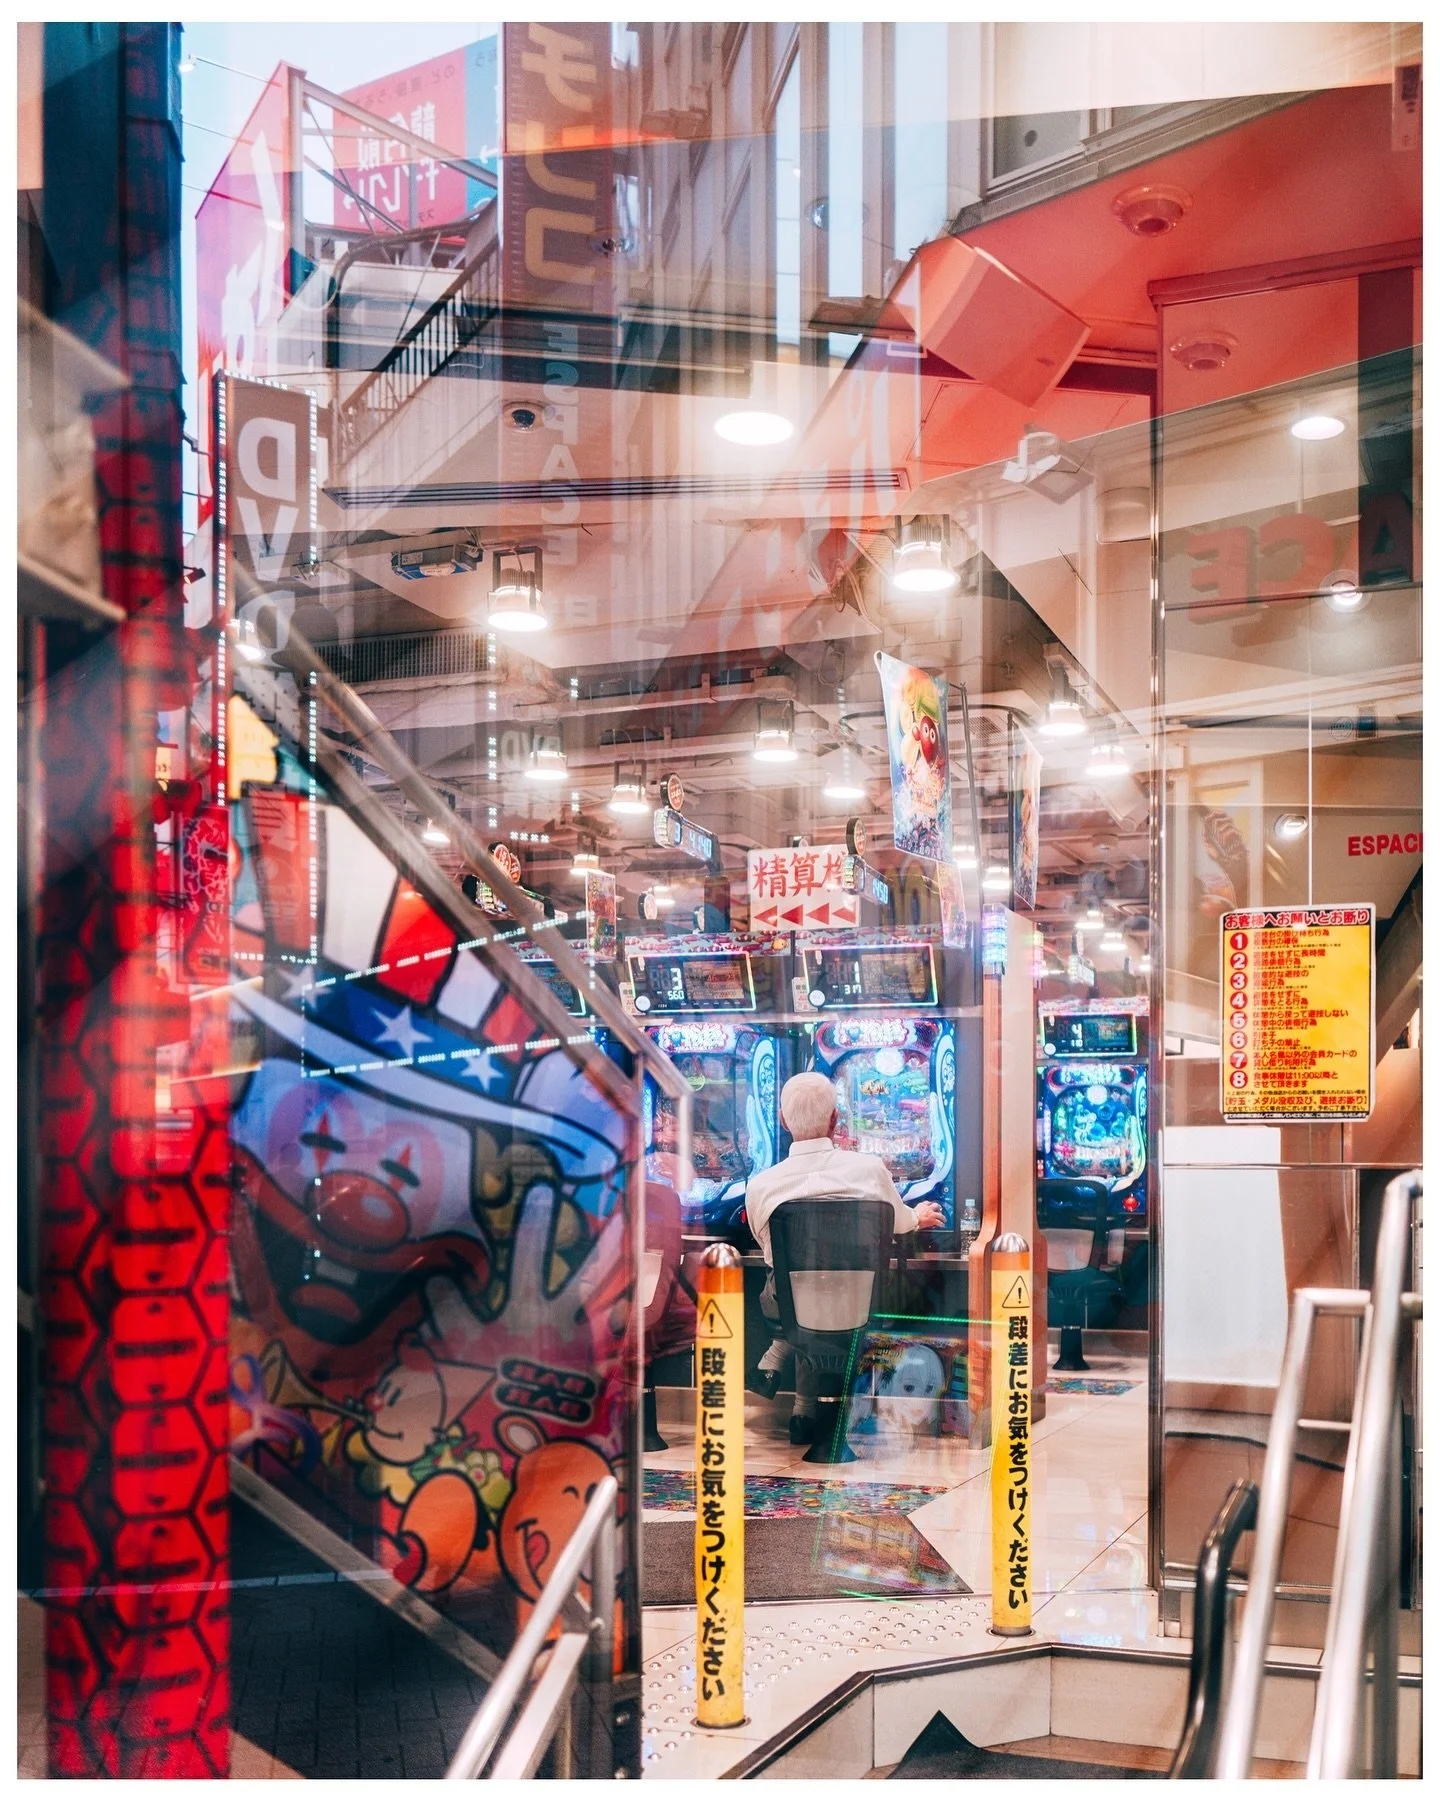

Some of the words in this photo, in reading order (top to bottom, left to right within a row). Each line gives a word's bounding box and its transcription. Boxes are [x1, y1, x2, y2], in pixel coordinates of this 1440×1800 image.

[1225, 909, 1370, 929] お客様へお願いとお断り
[670, 968, 682, 990] 3
[667, 990, 684, 1000] 560
[1007, 1315, 1031, 1612] 段差にお気をつけください
[698, 1347, 727, 1701] 段差にお気をつけください
